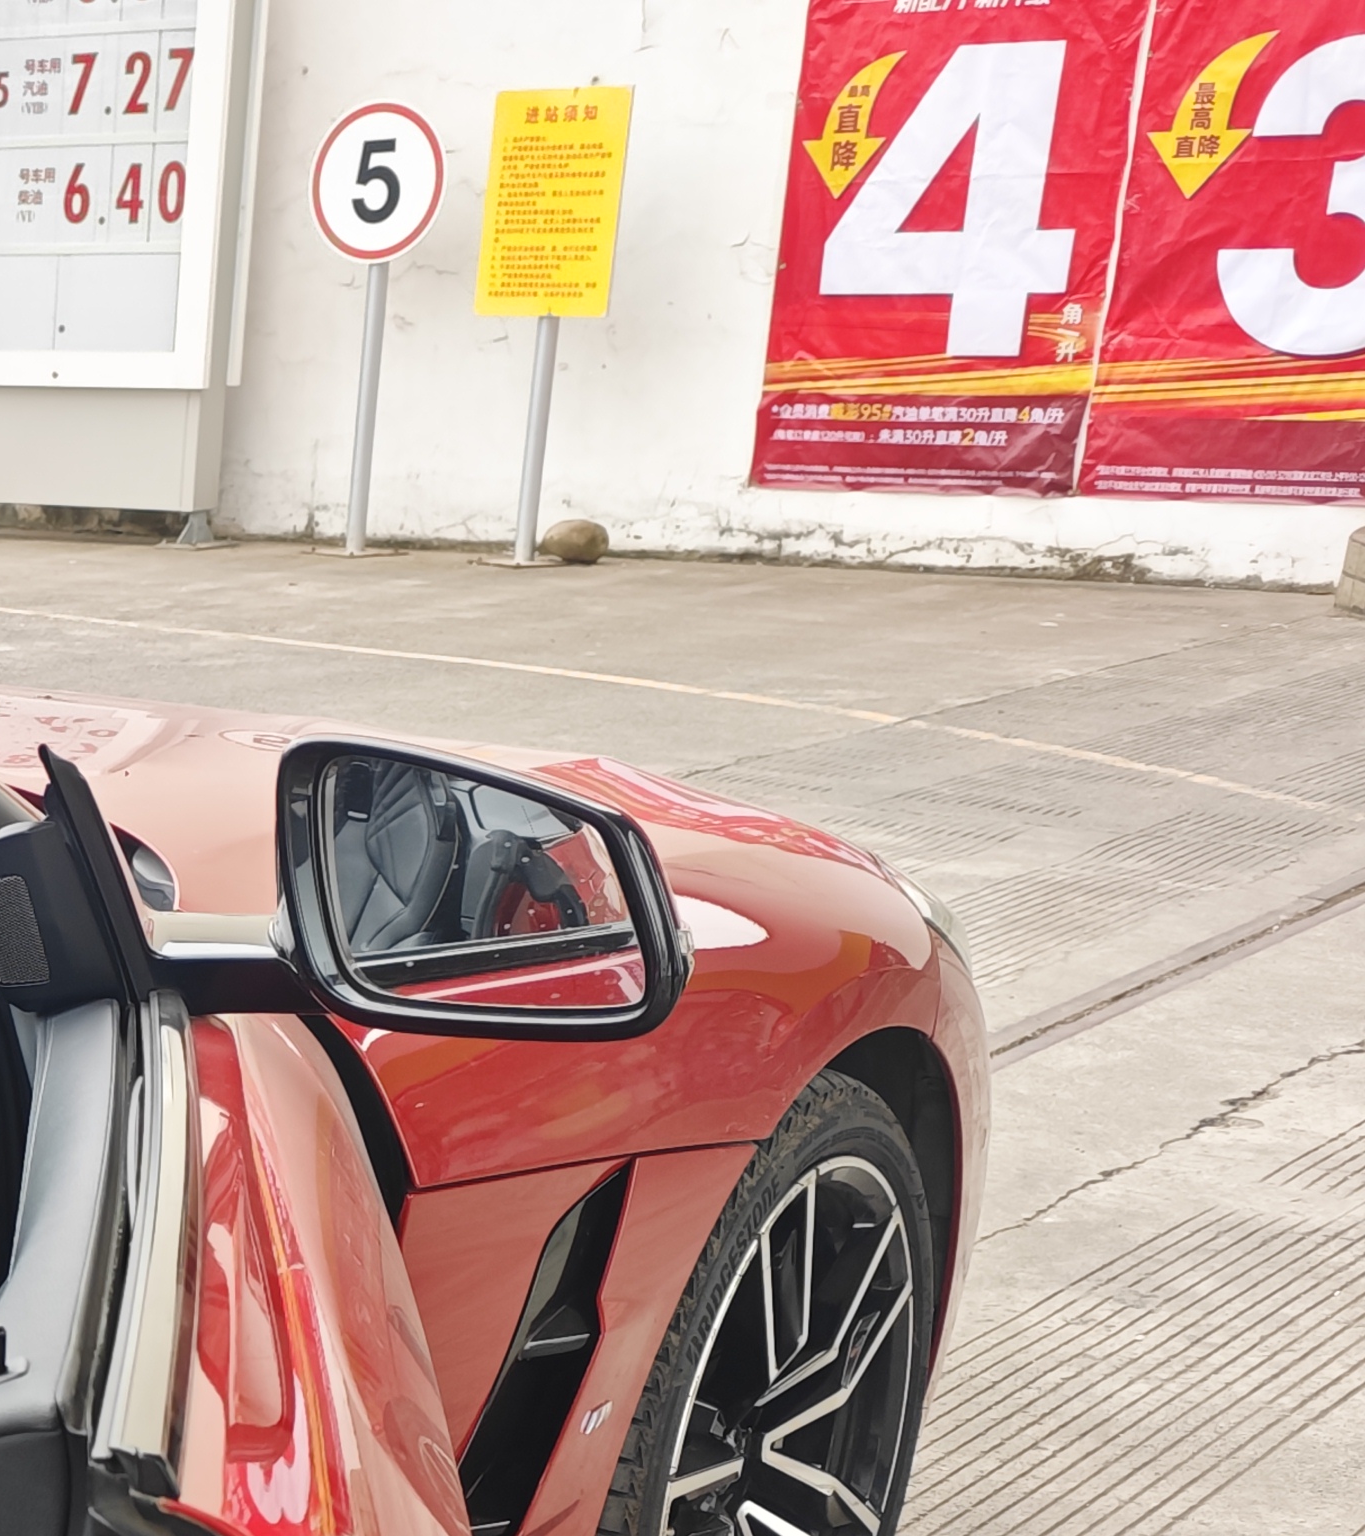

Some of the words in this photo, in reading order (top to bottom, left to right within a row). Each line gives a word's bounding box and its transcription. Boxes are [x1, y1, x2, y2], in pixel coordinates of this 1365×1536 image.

[22, 80, 49, 97] 汽油
[23, 58, 62, 75] 号车用
[68, 47, 195, 115] 7.27
[524, 104, 599, 125] 进站须知
[1189, 82, 1217, 131] 最高
[829, 103, 863, 172] 直降
[1171, 134, 1221, 159] 直降
[18, 167, 56, 185] 号车用
[63, 160, 187, 225] 6.40
[351, 137, 401, 224] 5
[819, 40, 1076, 357] 4
[1216, 33, 1365, 357] 3
